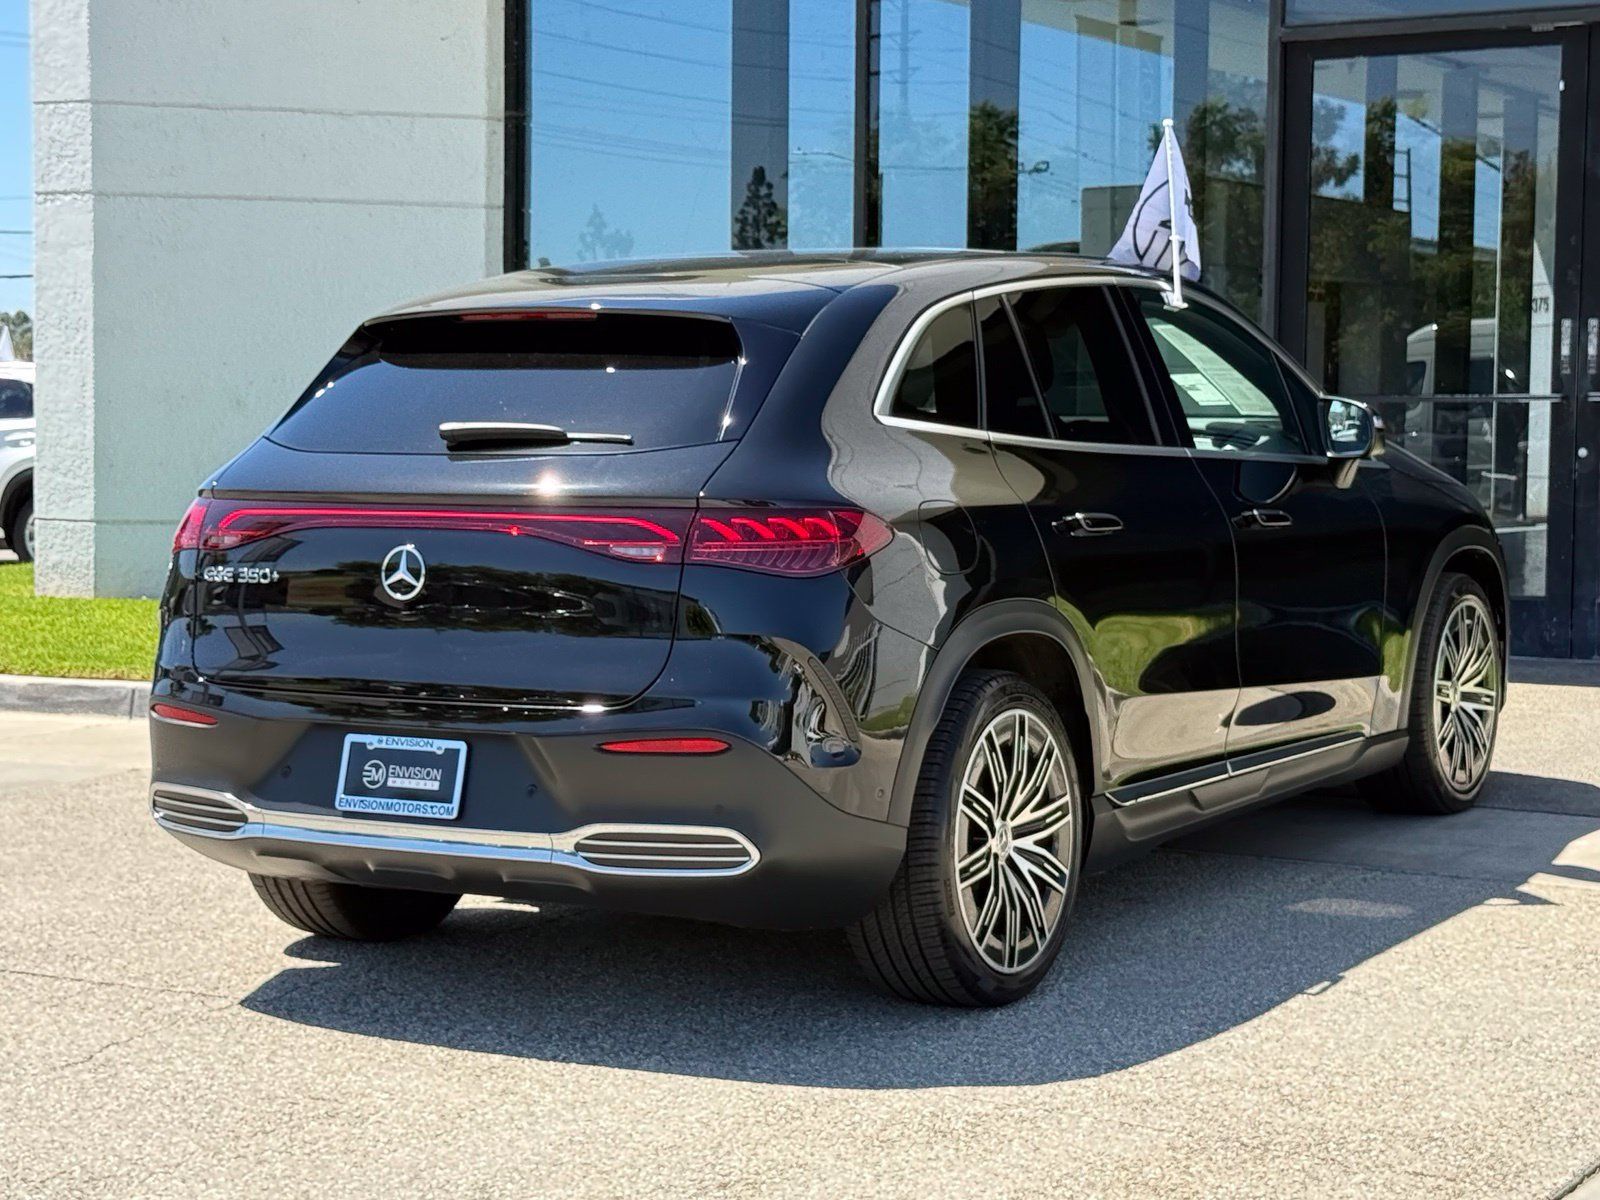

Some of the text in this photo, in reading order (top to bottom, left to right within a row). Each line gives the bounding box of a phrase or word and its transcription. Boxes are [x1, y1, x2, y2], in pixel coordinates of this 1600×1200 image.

[238, 566, 280, 584] 350+
[385, 736, 434, 749] ENVISION
[388, 764, 442, 781] ENVISION
[338, 798, 455, 817] ENVISIONMOTORS.COM
